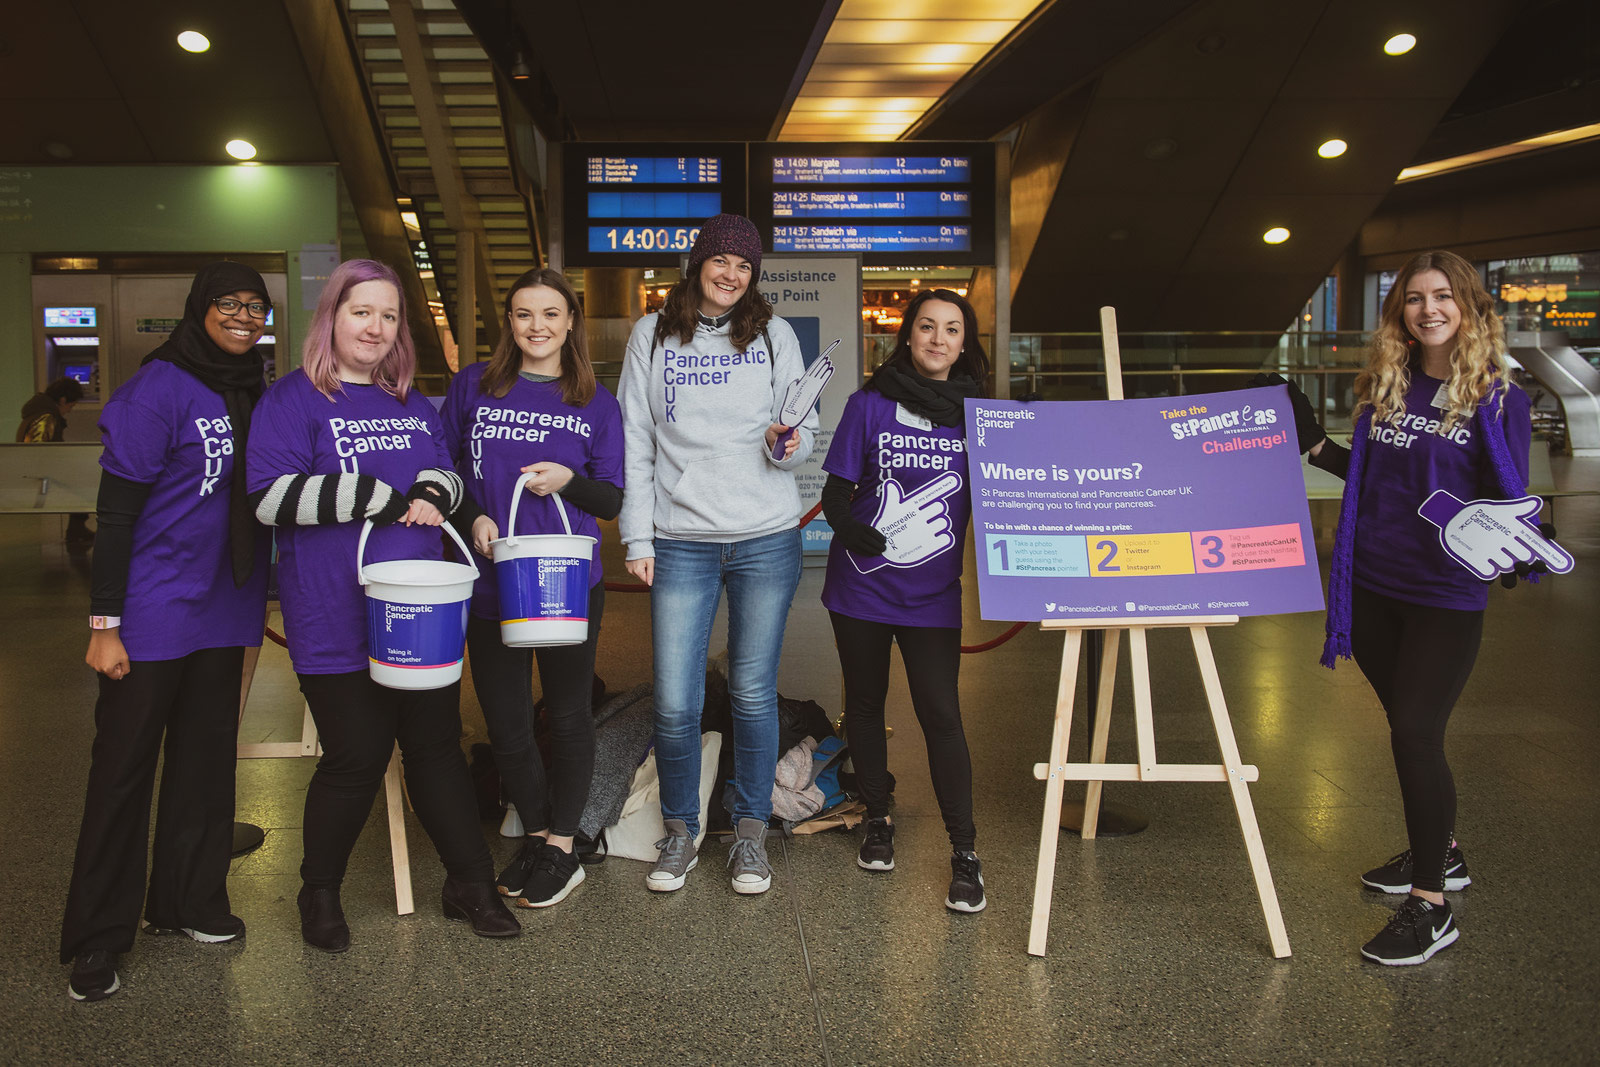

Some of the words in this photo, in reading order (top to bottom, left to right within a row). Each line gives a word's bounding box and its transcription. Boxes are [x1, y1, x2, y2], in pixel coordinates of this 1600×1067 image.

[811, 158, 840, 169] Margate
[896, 158, 906, 167] 12
[940, 158, 952, 167] On
[953, 158, 968, 167] time
[774, 192, 787, 202] 2nd
[811, 192, 845, 204] Ramsgate
[848, 193, 858, 202] via
[896, 192, 904, 201] 11
[940, 192, 952, 202] On
[953, 192, 968, 202] time
[774, 226, 786, 236] 3rd
[811, 226, 844, 236] Sandwich
[846, 227, 857, 236] via
[940, 226, 952, 236] On
[953, 226, 968, 236] time
[760, 270, 836, 282] Assistance
[783, 289, 820, 301] Point
[664, 347, 766, 368] Pancreatic
[664, 368, 731, 385] Cancer
[976, 407, 1035, 420] Pancreatic
[1160, 409, 1187, 420] Take
[1188, 406, 1208, 416] the
[329, 416, 431, 439] Pancreatic
[476, 406, 591, 438] Pancreatic
[976, 417, 1015, 428] Cancer
[472, 422, 550, 443] Cancer
[1224, 426, 1270, 435] INTERNATIONAL
[335, 434, 412, 458] Cancer
[1202, 430, 1287, 455] Challenge!
[878, 448, 952, 470] Cancer
[980, 462, 1047, 481] Where
[1052, 464, 1069, 481] is
[1074, 462, 1143, 484] yours?
[981, 488, 990, 497] St
[993, 489, 1025, 498] Pancras
[1027, 490, 1079, 499] International
[1081, 490, 1097, 498] and
[1099, 489, 1144, 498] Pancreatic
[1146, 488, 1177, 496] Cancer
[1179, 486, 1193, 495] UK
[997, 501, 1044, 510] challenging
[1093, 502, 1112, 510] your
[1115, 501, 1156, 510] pancreas.
[881, 511, 916, 534] Pancreatic
[1074, 524, 1104, 532] winning
[1112, 524, 1133, 532] prize:
[1470, 514, 1494, 532] Cancer
[1476, 508, 1512, 536] Pancreatic
[806, 530, 834, 540] StPan
[885, 524, 908, 539] Cancer
[1230, 537, 1297, 548] @PancreaticCanUK
[992, 540, 1009, 571] 1
[1096, 540, 1121, 571] 2
[1200, 535, 1225, 568] 3
[1270, 546, 1297, 554] hashtag
[1232, 557, 1276, 566] #StPancreas
[386, 603, 433, 612] Pancreatic
[1058, 605, 1118, 613] @PancreaticCanUK
[1138, 603, 1200, 612] @PancreaticCanUK
[1208, 601, 1249, 609] #StPancreas
[386, 611, 415, 619] Cancer
[387, 648, 406, 656] Taking
